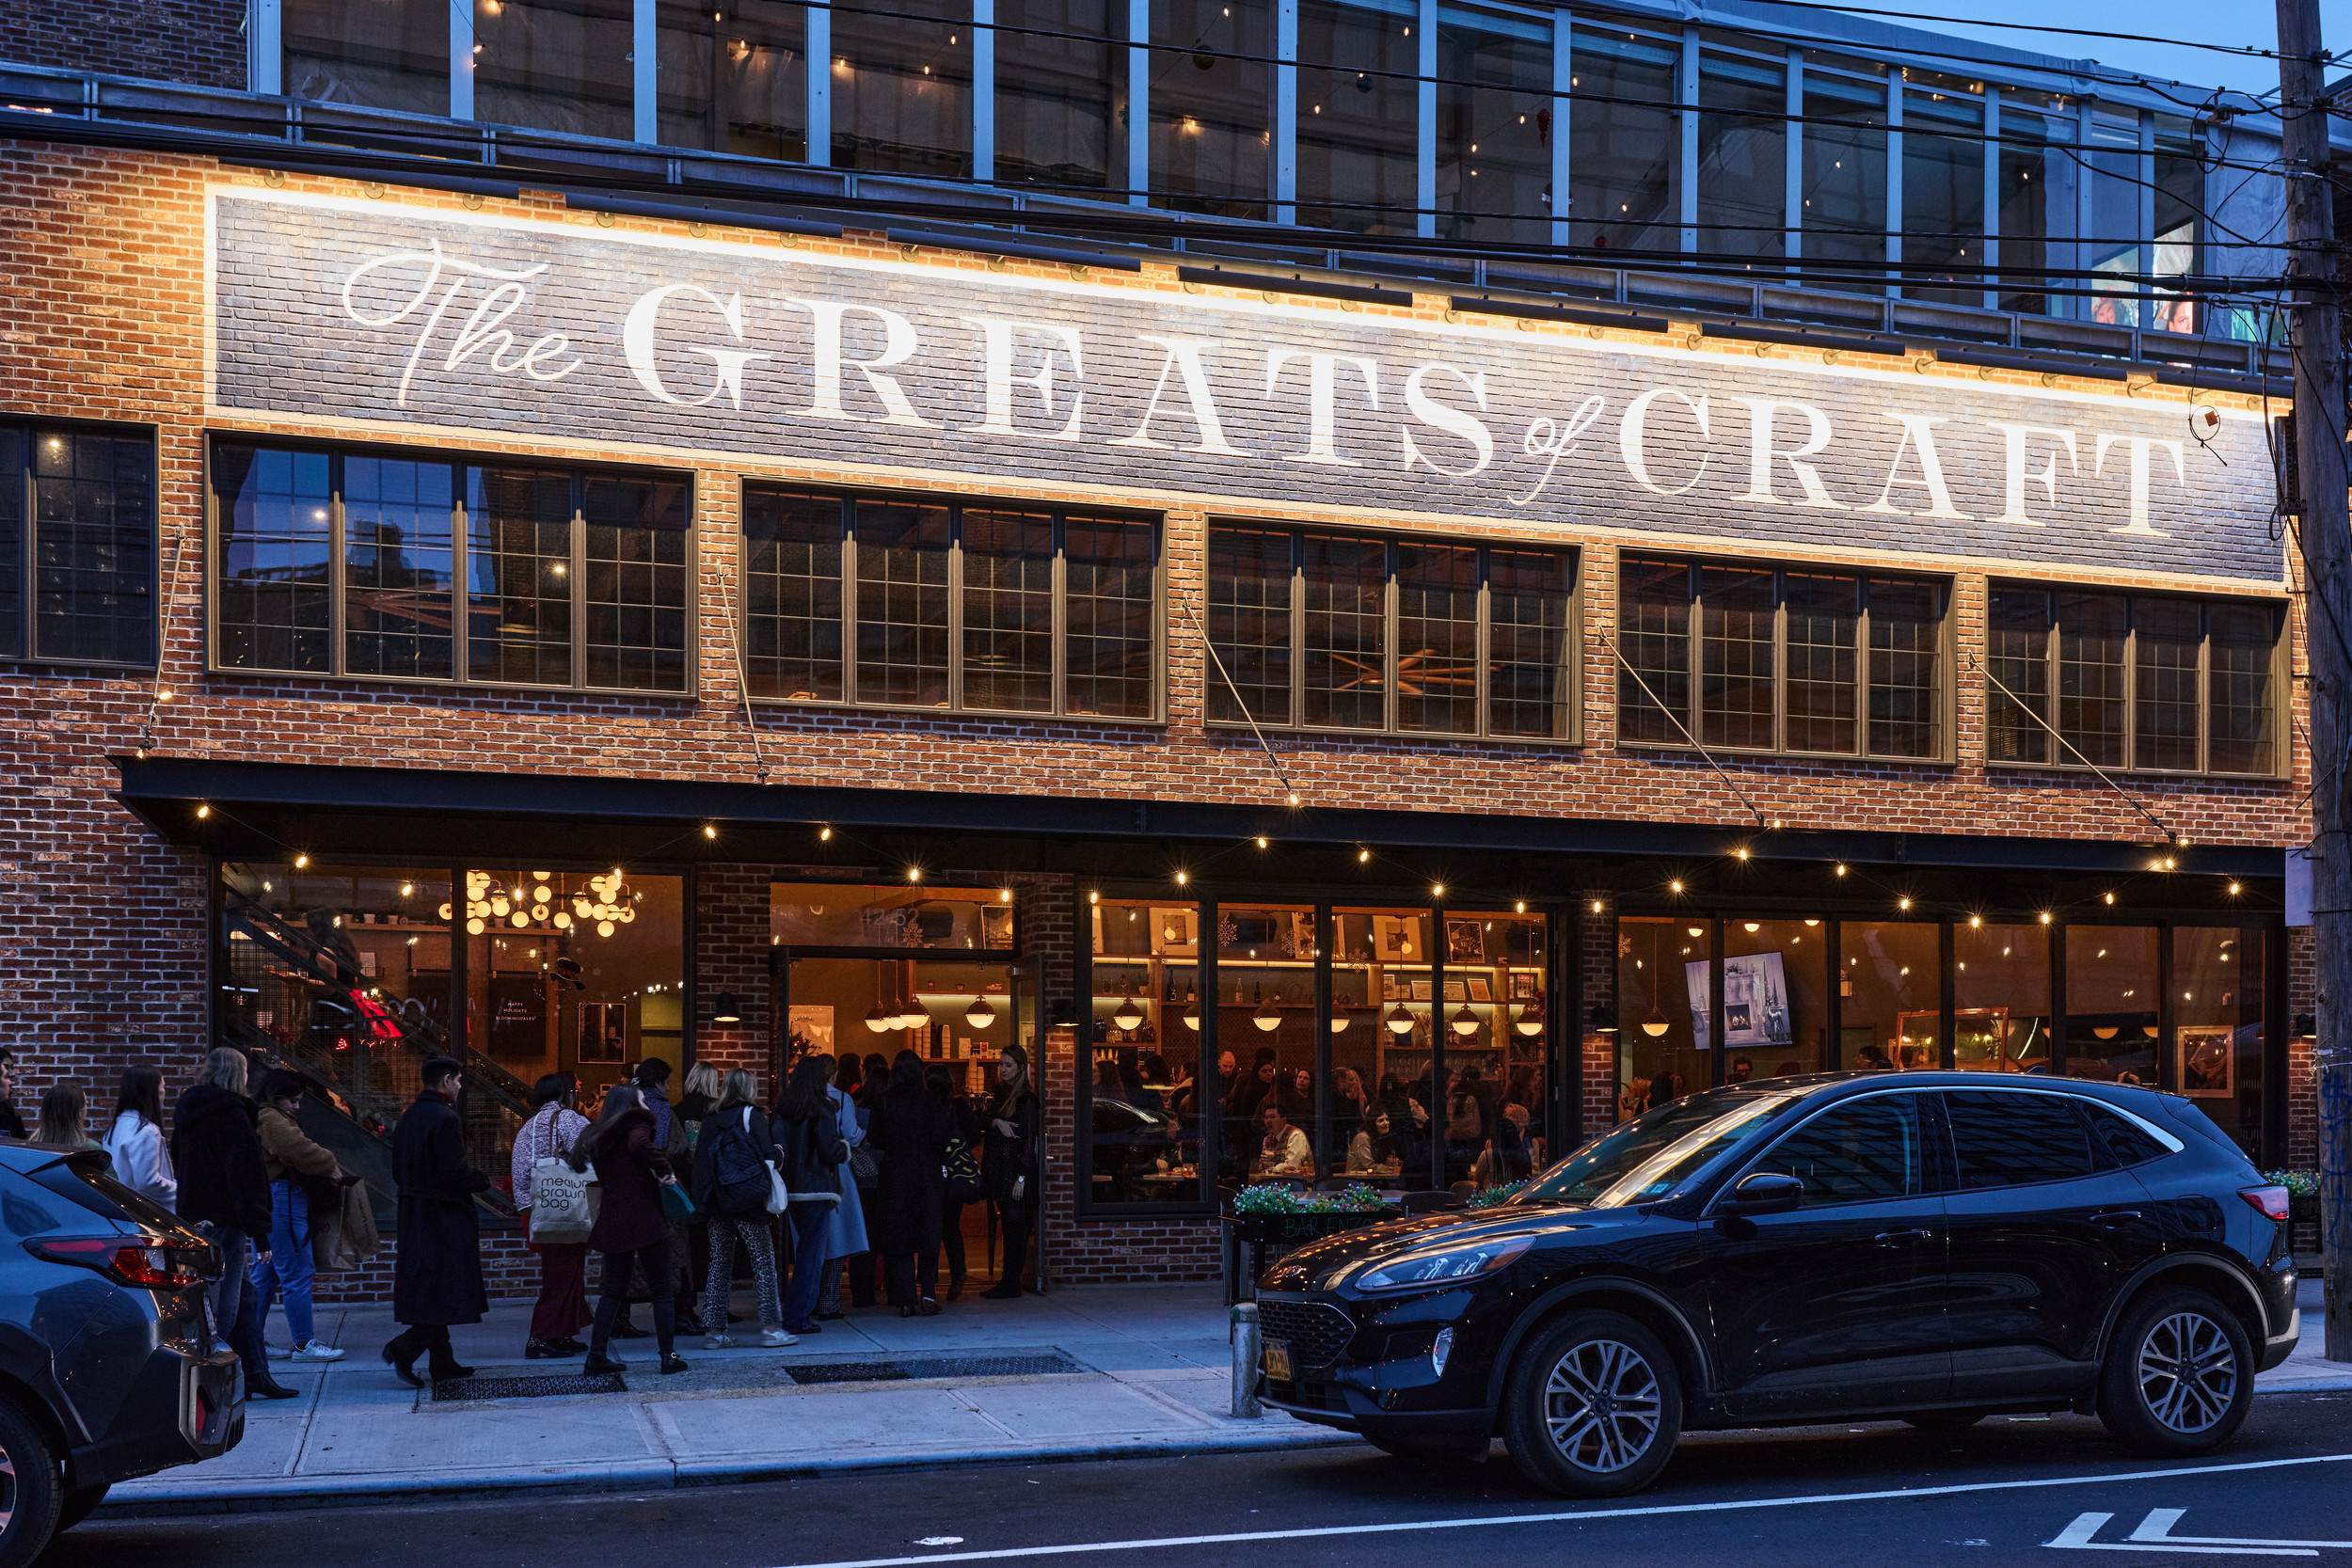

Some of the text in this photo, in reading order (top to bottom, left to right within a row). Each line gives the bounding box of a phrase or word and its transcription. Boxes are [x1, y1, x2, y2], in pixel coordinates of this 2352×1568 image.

[342, 237, 2185, 538] The GREATS of CRAFT
[541, 1187, 585, 1198] brown
[541, 1198, 569, 1212] bag
[1280, 1216, 1323, 1238] BAR
